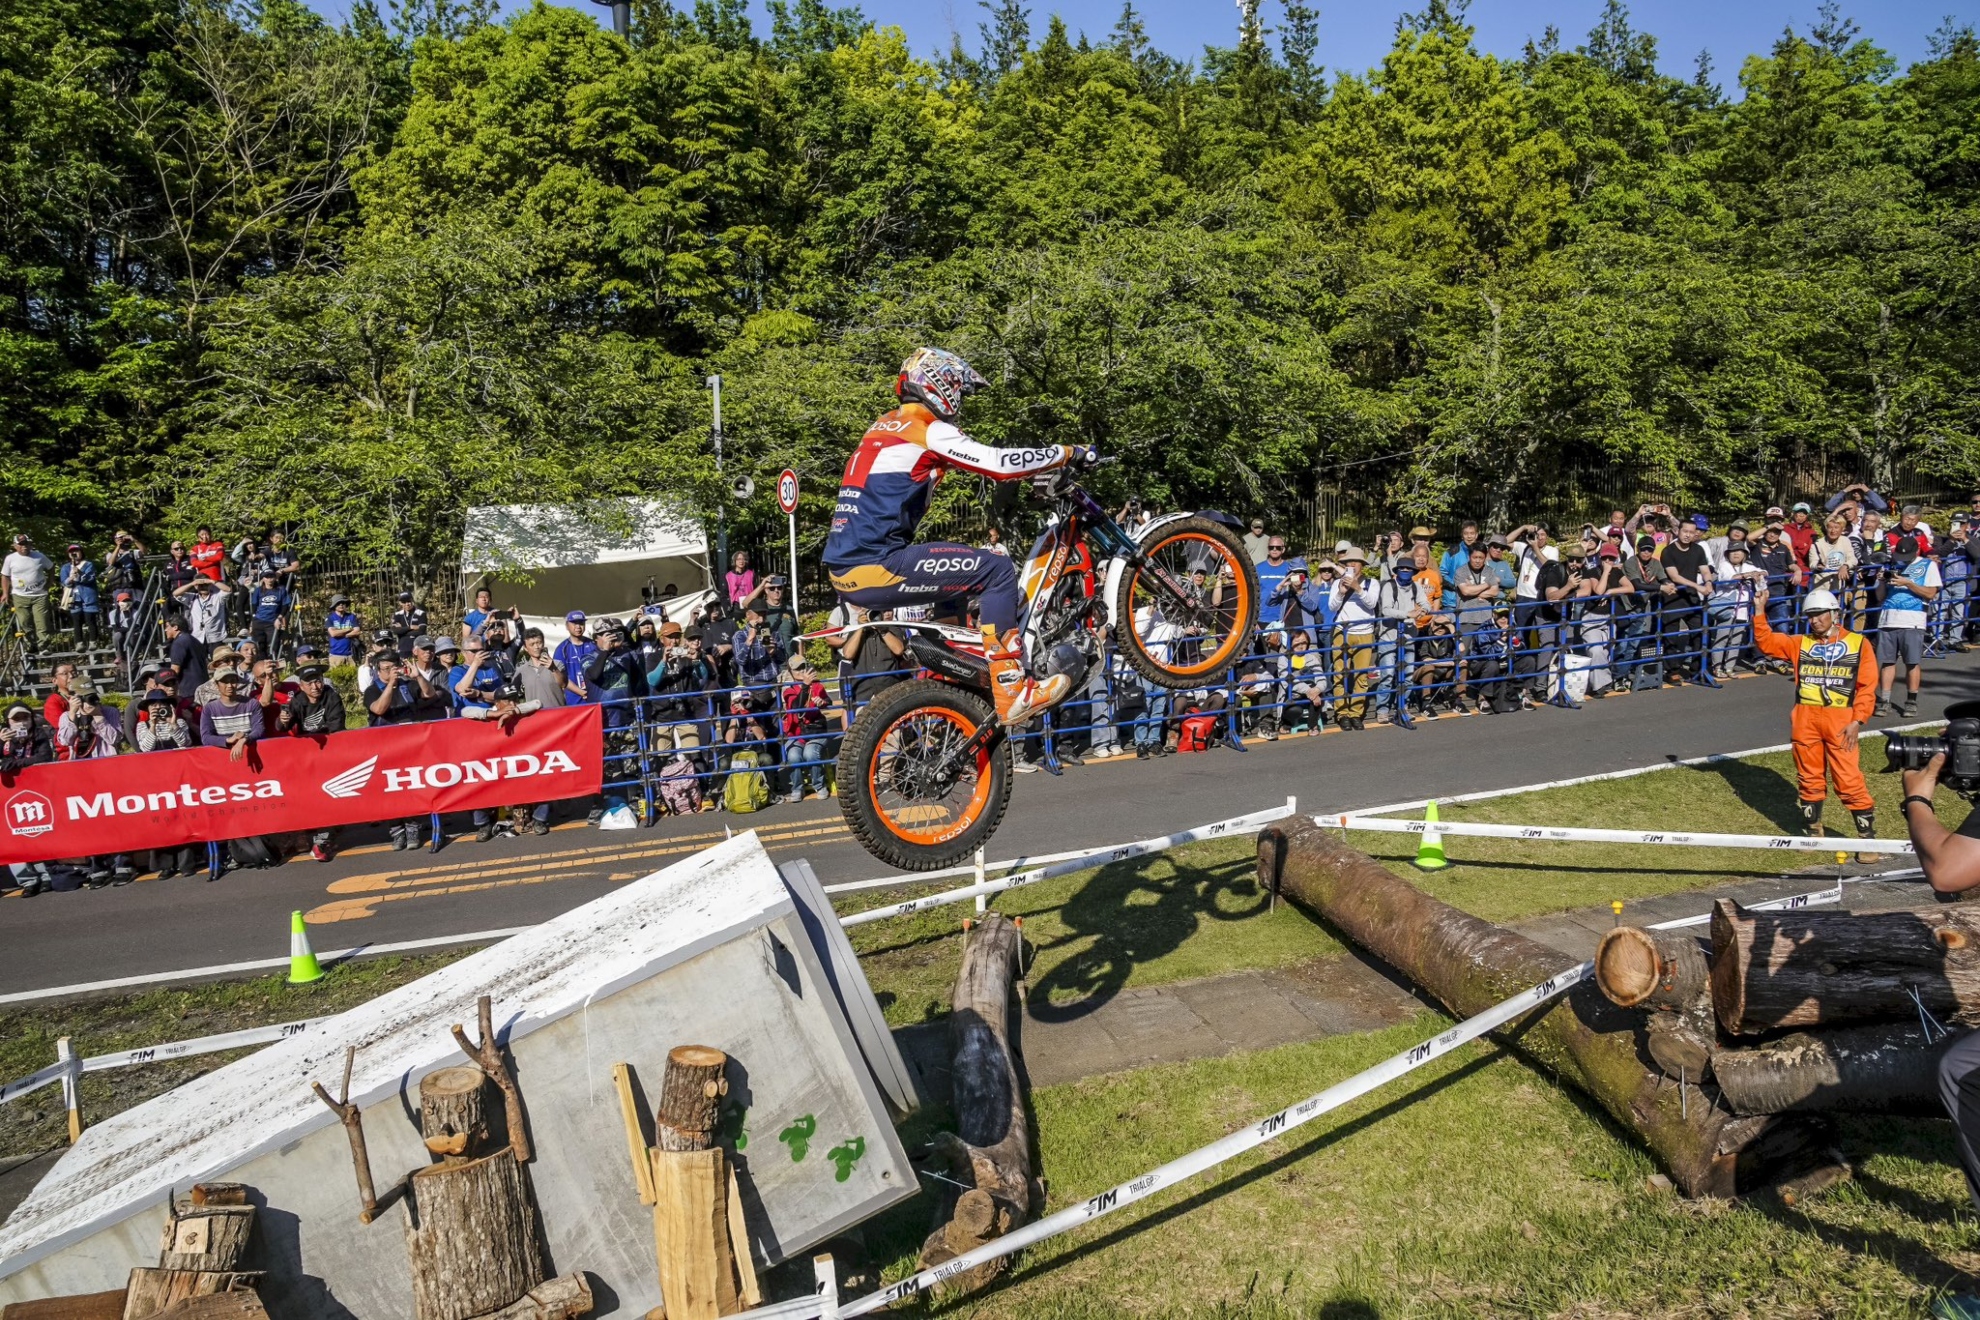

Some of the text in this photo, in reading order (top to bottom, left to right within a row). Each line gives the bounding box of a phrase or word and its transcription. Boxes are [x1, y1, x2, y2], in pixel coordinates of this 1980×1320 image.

[849, 451, 861, 476] 1
[947, 448, 980, 463] hebo
[1001, 446, 1059, 469] repsol
[782, 481, 795, 501] 30
[839, 488, 861, 498] ebo
[835, 503, 860, 514] ONDA
[914, 556, 981, 576] repsol
[1048, 541, 1069, 582] repsol
[898, 583, 939, 593] hebo
[1805, 677, 1843, 685] OBSEVER
[382, 750, 581, 792] HONDA
[66, 779, 284, 821] Montesa
[151, 801, 287, 824] World Champion
[15, 825, 50, 834] Montesa
[933, 816, 972, 843] repsol
[1520, 828, 1542, 837] FIM
[1641, 834, 1664, 843] FIM
[1768, 838, 1792, 848] FIM
[896, 902, 917, 913] FIM
[1006, 875, 1027, 887] FIM
[1112, 848, 1129, 861] FIM
[1209, 823, 1226, 834] FIM
[127, 1049, 155, 1064] FIM
[279, 1022, 306, 1037] FIM
[933, 1261, 963, 1281] TRIALGP
[1083, 1189, 1118, 1216] FIM
[1129, 1176, 1154, 1195] TRIALGP
[1257, 1111, 1287, 1136] FIM
[1296, 1099, 1318, 1116] TRIALGP
[1405, 1041, 1431, 1064] FIM
[1439, 1030, 1459, 1047] TRIALGP
[1533, 979, 1556, 999] FIM
